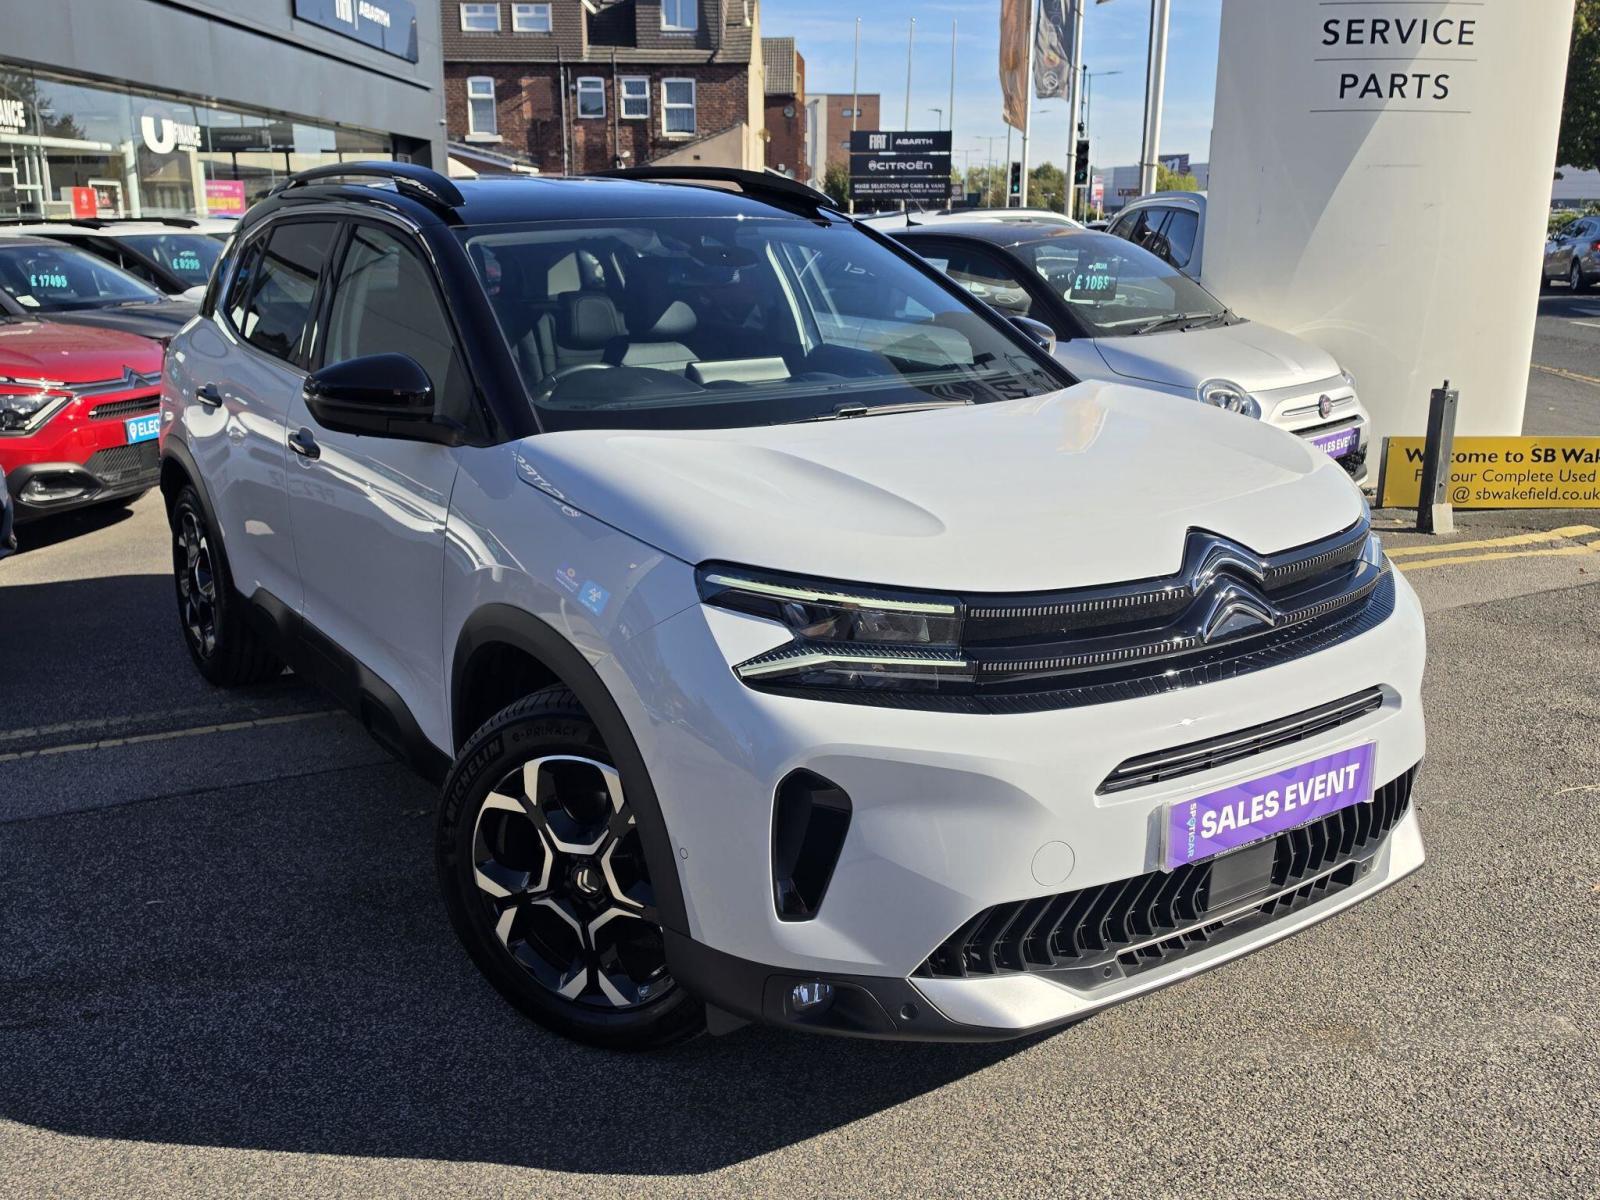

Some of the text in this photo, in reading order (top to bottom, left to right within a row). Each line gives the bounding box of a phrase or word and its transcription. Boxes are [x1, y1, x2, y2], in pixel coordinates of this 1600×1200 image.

[1321, 18, 1476, 46] SERVICE
[1339, 73, 1450, 100] PARTS
[868, 134, 934, 150] FIAT ABARTH
[1315, 434, 1358, 453] ALES EVENT
[1405, 448, 1498, 463] Wome
[1505, 450, 1524, 463] to
[1531, 448, 1557, 463] SB
[1451, 469, 1597, 486] our Complete Used
[1453, 486, 1600, 503] @ sbwakefield.co.uk
[446, 740, 500, 822] MICHELIN
[1200, 763, 1361, 839] SALES EVENT
